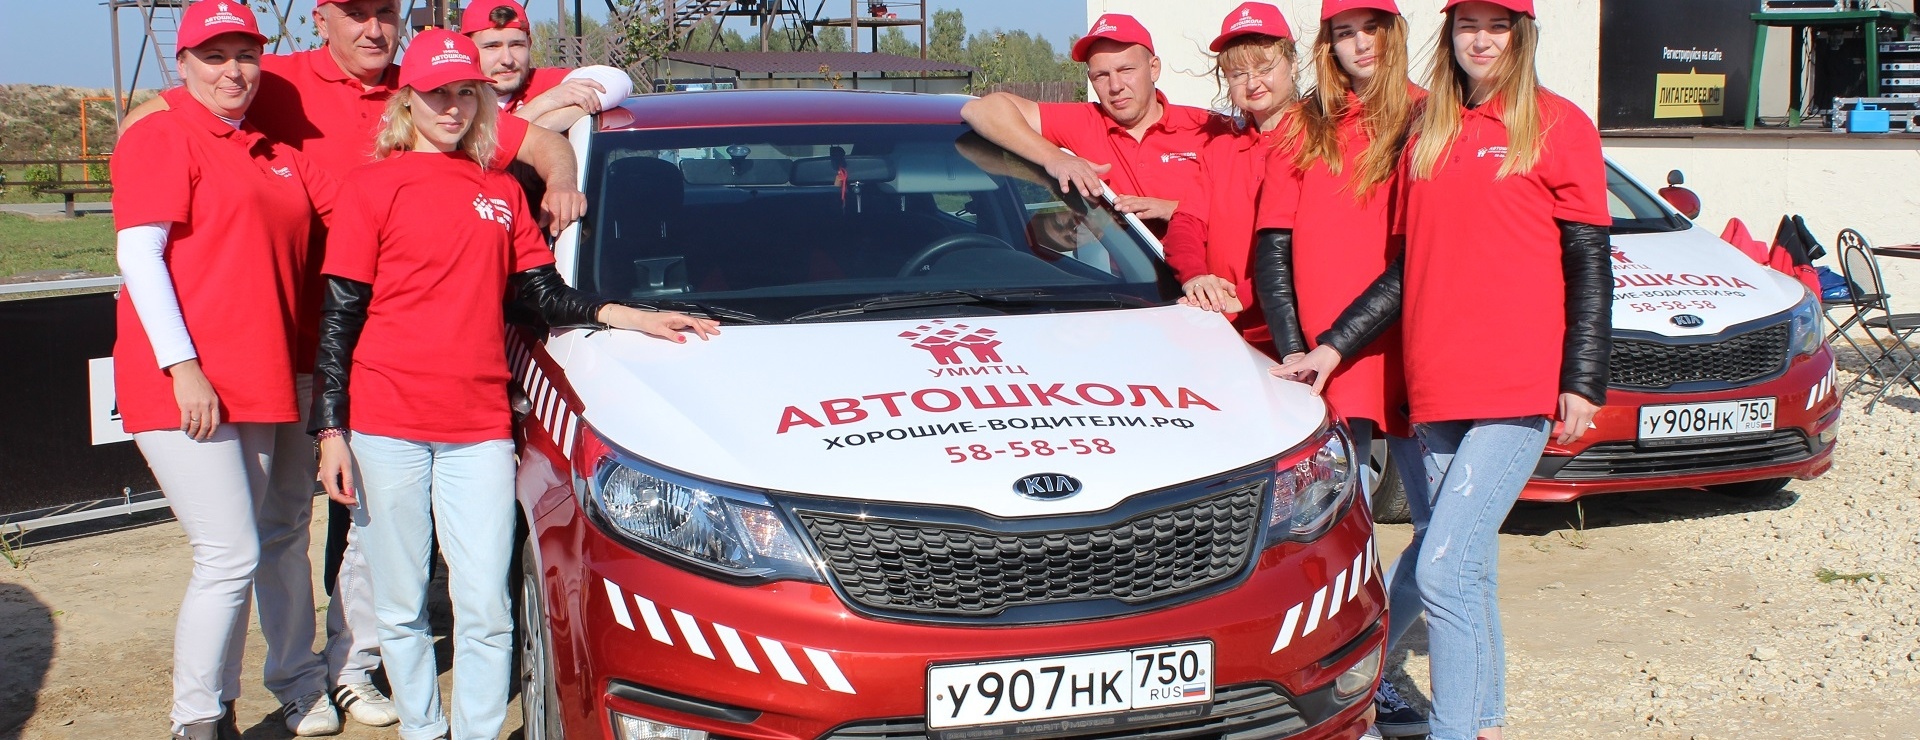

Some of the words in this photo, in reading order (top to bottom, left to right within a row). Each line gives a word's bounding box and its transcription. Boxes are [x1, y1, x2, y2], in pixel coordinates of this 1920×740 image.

[432, 54, 470, 62] АВТОШКОЛА
[1663, 47, 1701, 62] Регистрируйся
[1702, 51, 1708, 60] на
[1709, 48, 1722, 61] сайте
[1660, 86, 1720, 104] ЛИГАГЕРОЕВ.РФ
[1630, 300, 1717, 313] 58-58-58
[1674, 314, 1700, 325] KIA
[927, 365, 1029, 378] УМИТЦ
[776, 383, 1222, 434] АВТОШКОЛА
[1740, 402, 1769, 421] 750
[1746, 421, 1761, 429] RUS
[822, 415, 1195, 451] ХОРОШИЕ-ВОДИТЕЛИ.РФ
[944, 438, 1116, 464] 58-58-58
[1025, 475, 1075, 496] KIA
[1136, 650, 1199, 688] 750
[1150, 685, 1182, 700] RUS
[1016, 723, 1061, 734] FAVORIT
